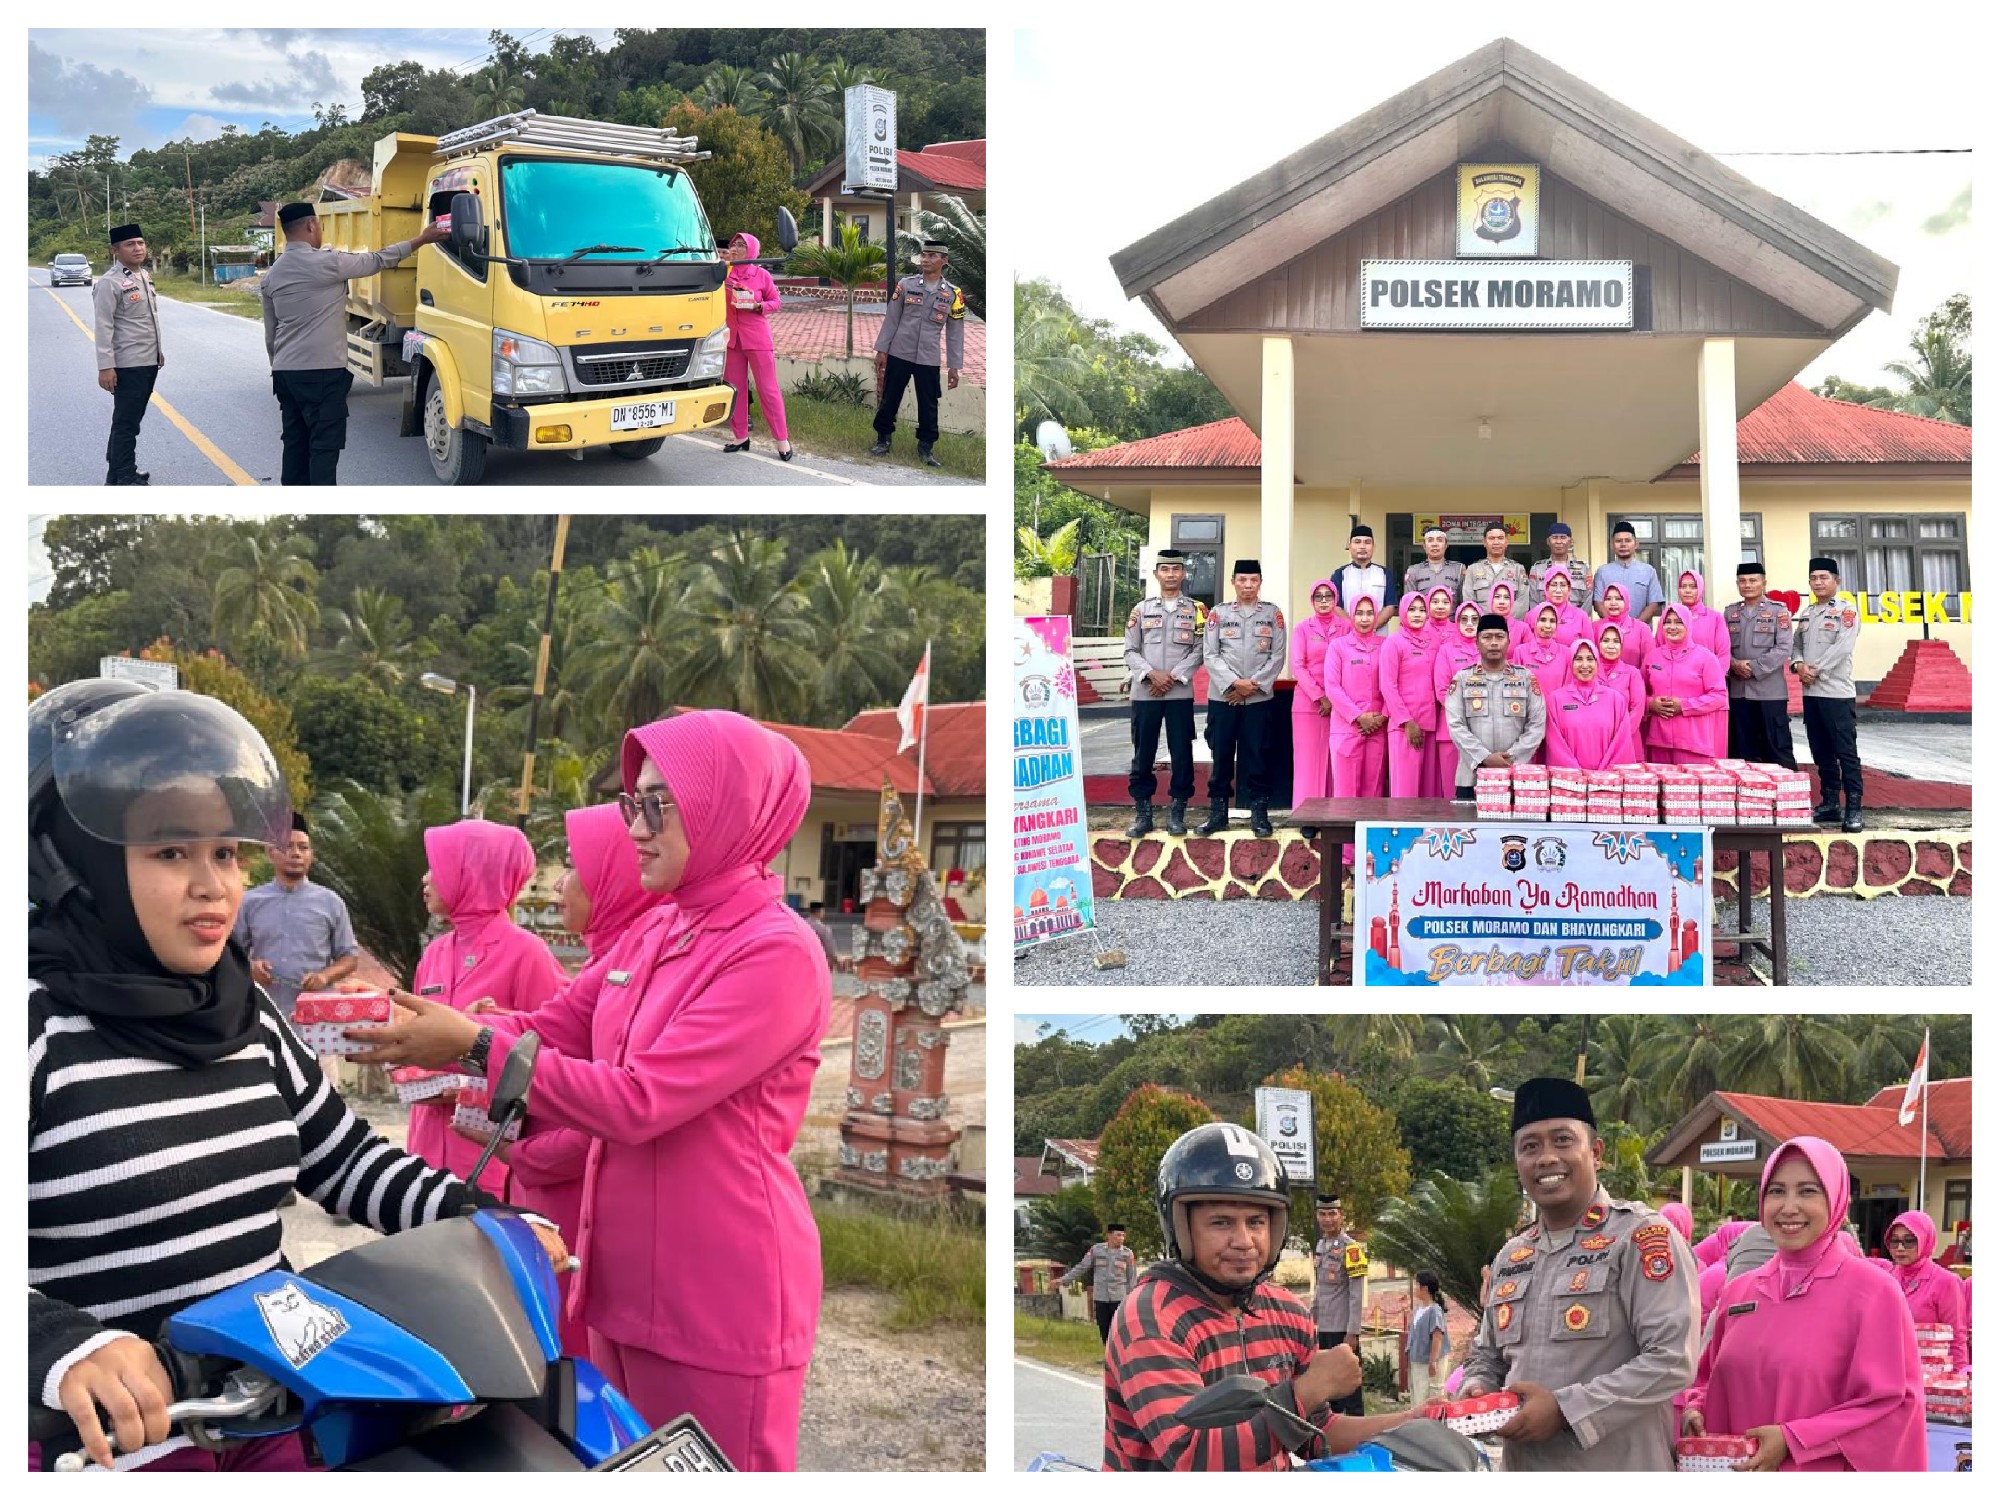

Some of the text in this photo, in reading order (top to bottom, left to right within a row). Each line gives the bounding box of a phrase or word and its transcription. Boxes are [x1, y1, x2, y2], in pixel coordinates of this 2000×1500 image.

[869, 144, 893, 156] POLISI
[1370, 279, 1624, 308] POLSEK MORAMO
[576, 323, 694, 339] FUSO
[613, 407, 627, 423] DN
[632, 403, 657, 421] 8556
[1014, 752, 1073, 788] ADHAN
[1411, 878, 1658, 914] Marhaban Ya Ramadhan
[1424, 920, 1646, 937] POLSEK MORAMO DAN BHAYANGKARI
[1426, 943, 1645, 981] Berbagi Takjil
[1271, 1141, 1307, 1150] POLISI
